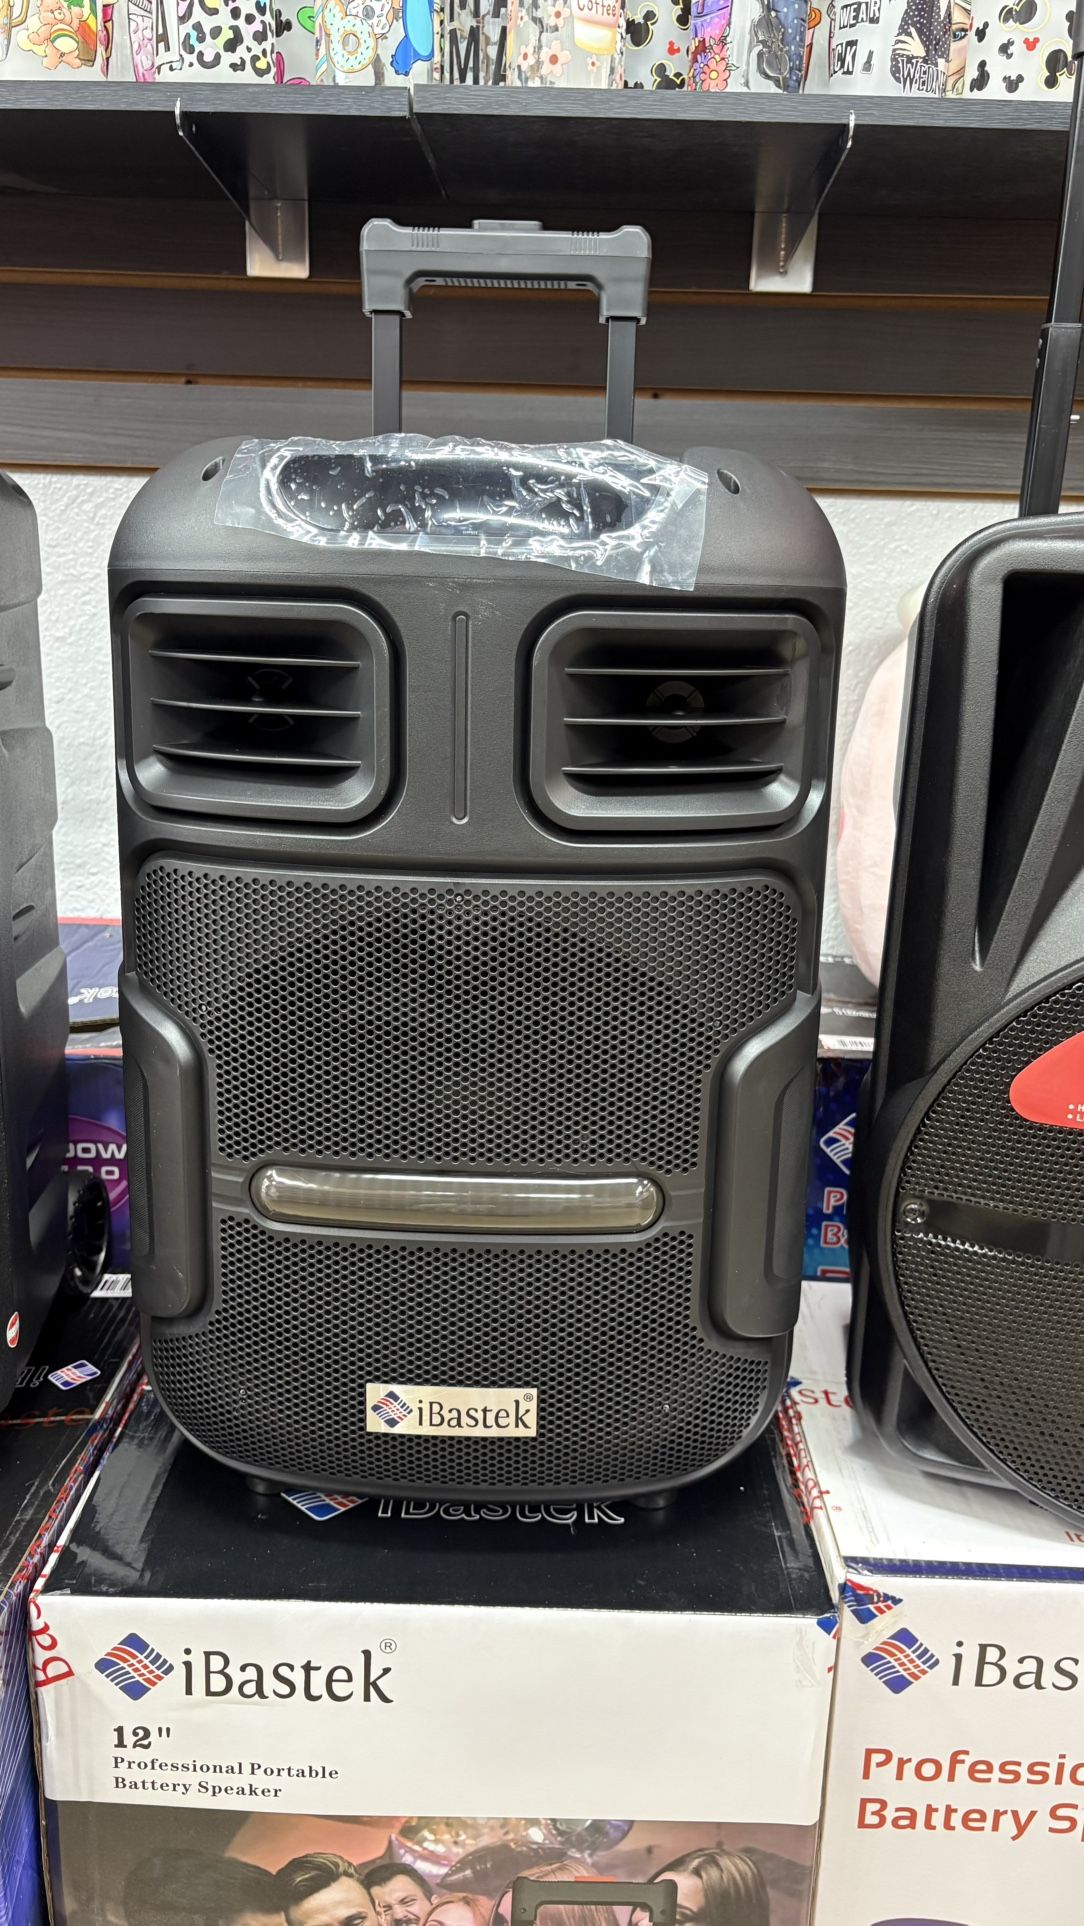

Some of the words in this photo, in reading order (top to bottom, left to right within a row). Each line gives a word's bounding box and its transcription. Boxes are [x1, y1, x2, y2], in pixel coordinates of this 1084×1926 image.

[577, 0, 616, 17] Coffee
[840, 0, 880, 28] WEAR
[113, 1725, 171, 1749] 12"
[112, 1756, 243, 1775] Professional
[249, 1762, 339, 1779] Portable
[113, 1776, 192, 1795] Battery
[197, 1781, 282, 1797] Speaker
[857, 1797, 1038, 1842] Battery
[1048, 1802, 1084, 1843] S
